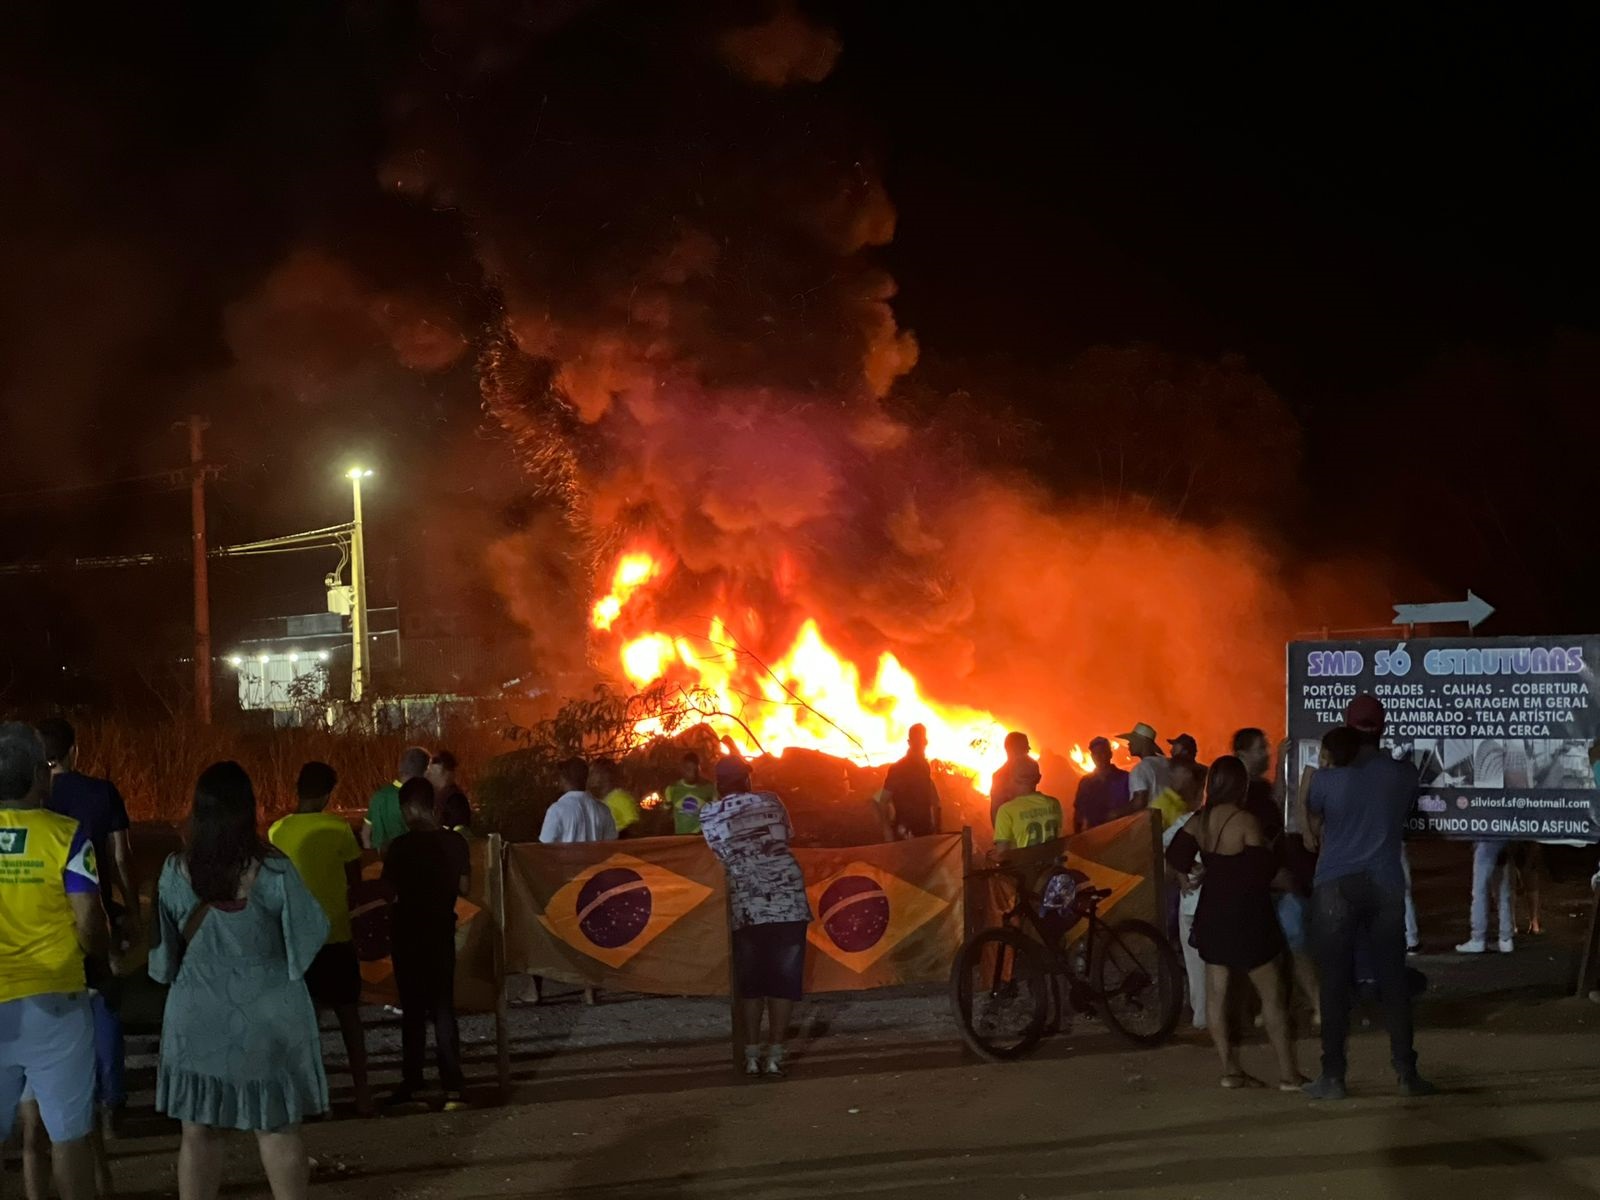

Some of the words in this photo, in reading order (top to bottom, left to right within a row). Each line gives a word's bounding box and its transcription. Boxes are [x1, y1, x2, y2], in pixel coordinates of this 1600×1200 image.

[1308, 651, 1363, 676] SMD
[1374, 643, 1411, 676] SÓ
[1424, 647, 1583, 676] ESTRUTURAS
[1303, 683, 1357, 696] PORTÕES
[1375, 684, 1423, 696] GRADES
[1443, 684, 1492, 695] CALHAS
[1512, 683, 1589, 695] COBERTURA
[1304, 696, 1353, 709] METÁLIC
[1377, 698, 1442, 709] SIDENCIAL
[1454, 698, 1519, 709] GARAGEM
[1524, 697, 1541, 709] EM
[1546, 697, 1588, 708] GERAL
[1317, 711, 1344, 723] TELA
[1384, 711, 1464, 723] ALAMBRADO
[1476, 711, 1505, 723] TELA
[1509, 708, 1575, 722] ARTÍSTICA
[1399, 725, 1467, 736] CONCRETO
[1470, 725, 1505, 736] PARA
[1508, 724, 1550, 736] CERCA
[1470, 796, 1590, 809] silviosf.sf@hotmail.com
[1428, 818, 1468, 831] FUNDO
[1471, 819, 1488, 832] DO
[1491, 816, 1539, 832] GINÁSIO
[1541, 820, 1590, 833] ASFUNC
